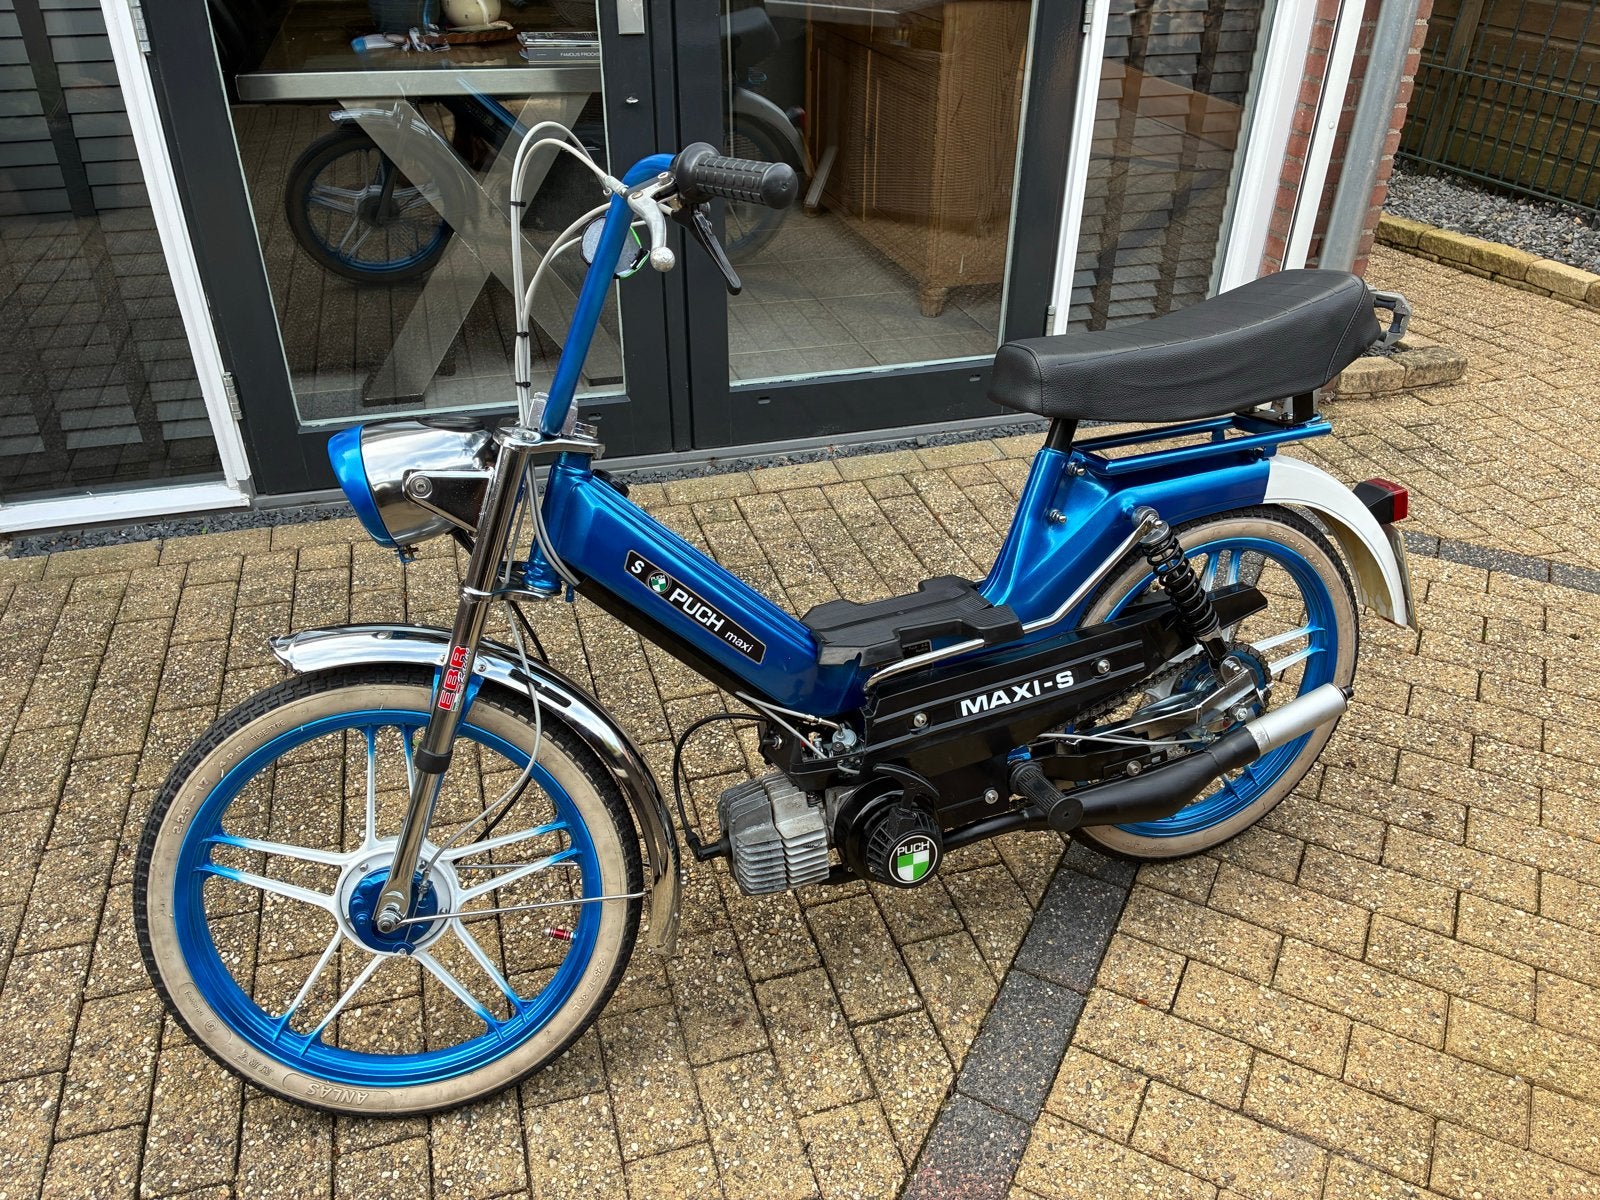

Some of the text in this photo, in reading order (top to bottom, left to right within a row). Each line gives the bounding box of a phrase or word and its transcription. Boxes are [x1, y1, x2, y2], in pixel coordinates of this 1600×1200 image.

[631, 560, 754, 653] S PUCH maxi
[438, 645, 467, 710] EBR
[960, 670, 1074, 717] MAXI-S
[897, 840, 930, 857] PUCH
[306, 1083, 369, 1105] ANLAS
